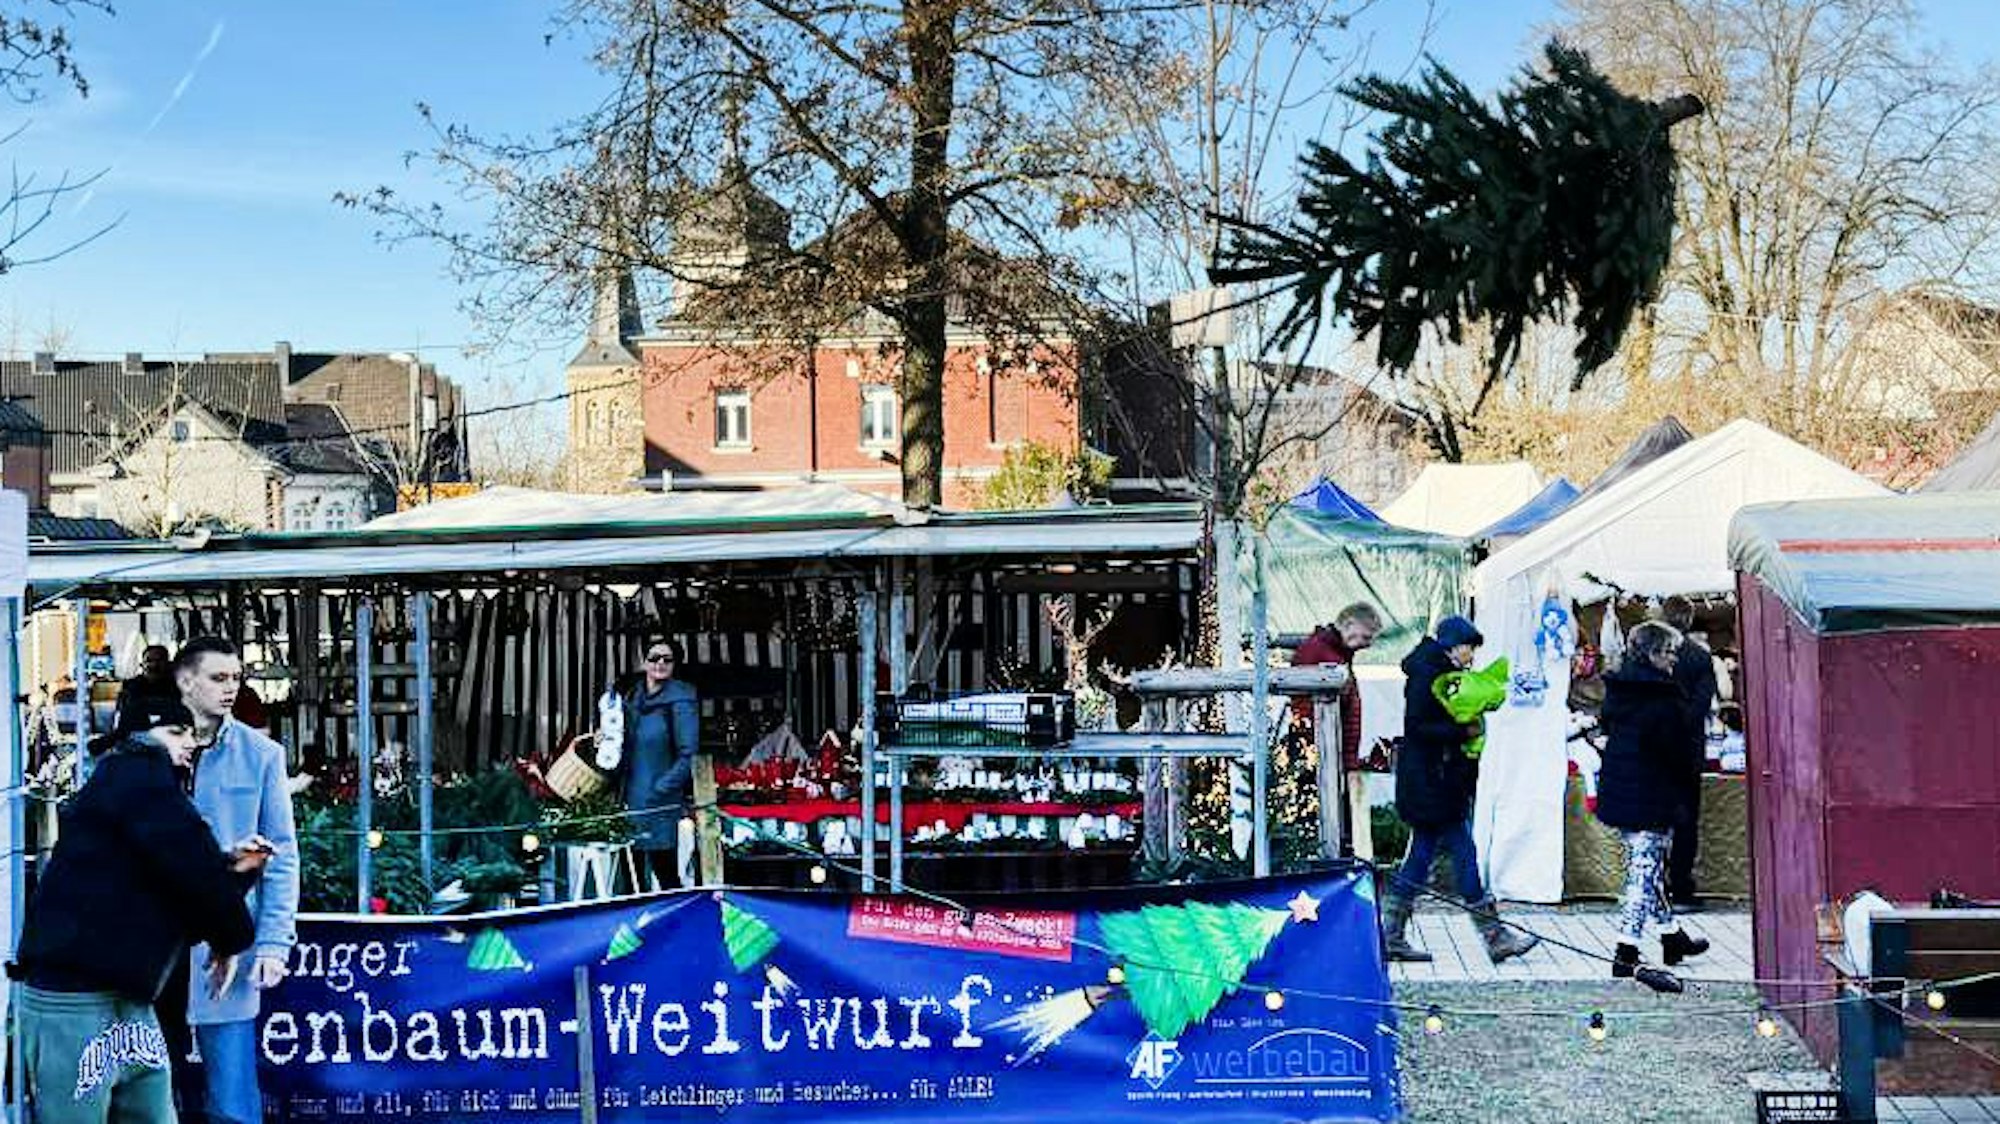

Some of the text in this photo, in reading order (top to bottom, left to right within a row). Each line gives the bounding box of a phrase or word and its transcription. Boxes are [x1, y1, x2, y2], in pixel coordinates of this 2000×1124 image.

[943, 908, 999, 928] guen
[281, 938, 418, 992] nger
[1129, 1034, 1371, 1079] AF werbebau
[422, 1088, 450, 1112] für
[508, 1087, 538, 1110] und
[601, 1085, 630, 1107] für
[639, 1082, 745, 1114] Leichlinger
[753, 1081, 785, 1103] und
[909, 1078, 939, 1099] für
[947, 1076, 994, 1099] ALLE!
